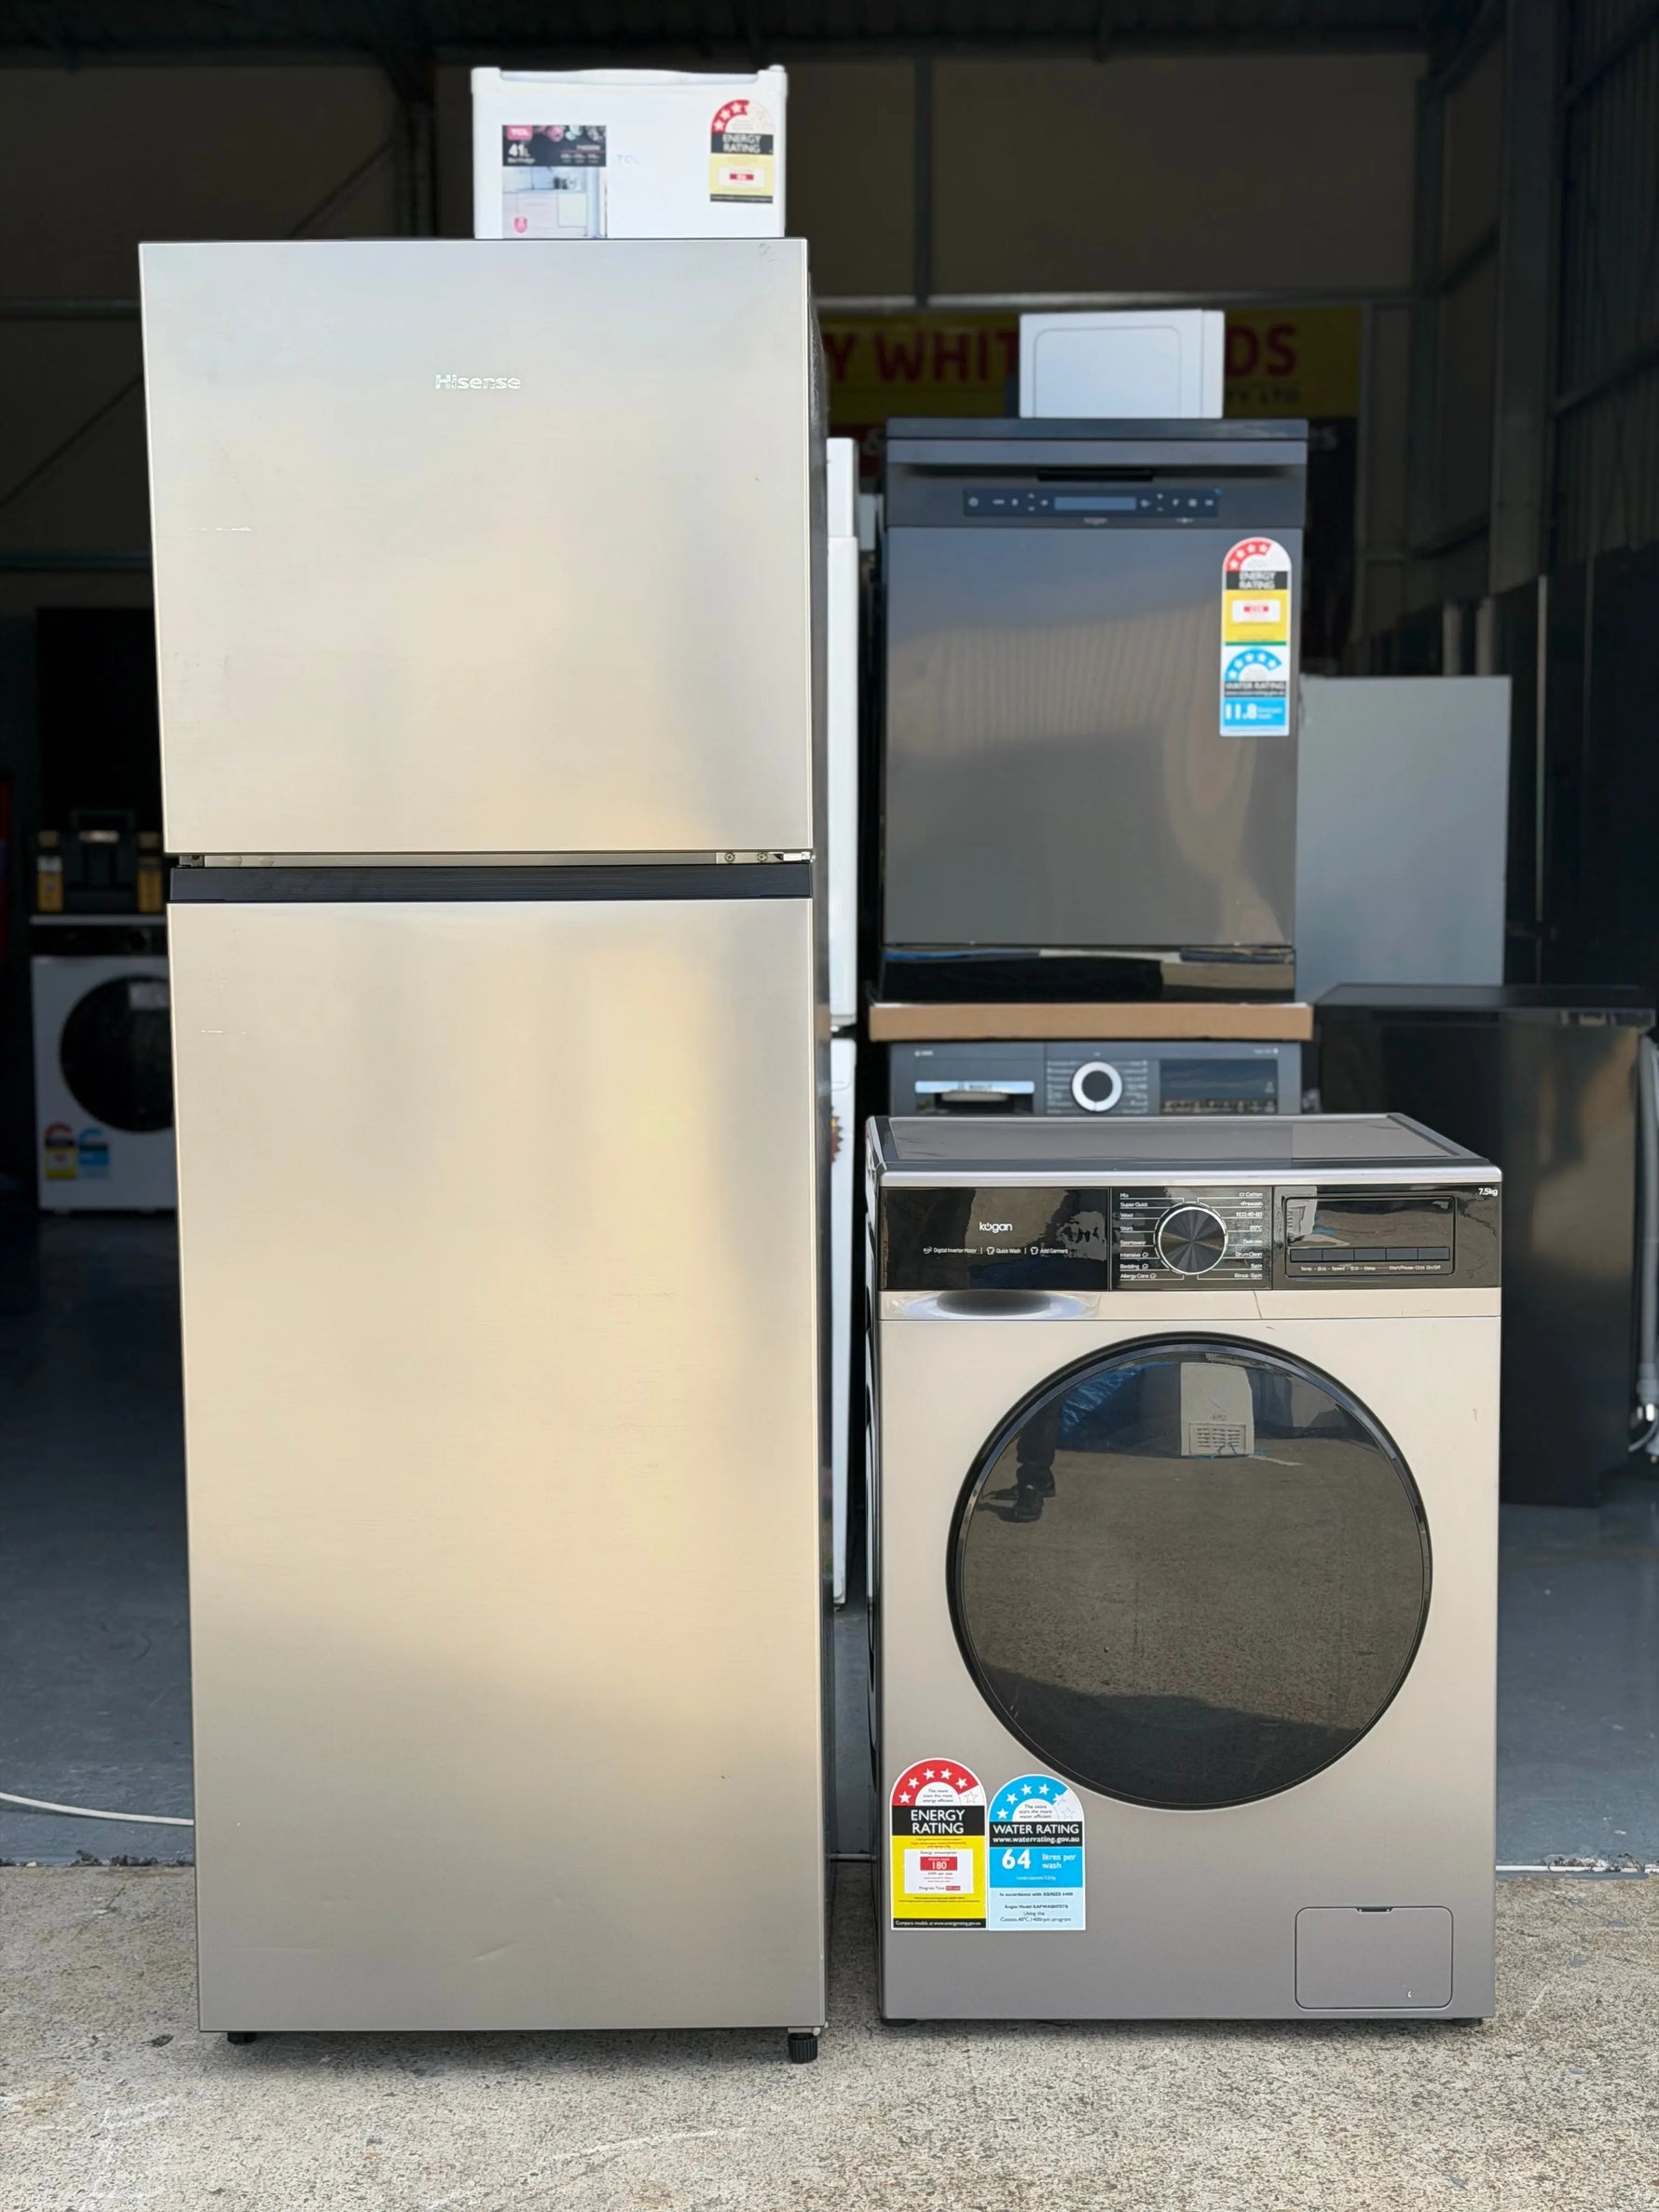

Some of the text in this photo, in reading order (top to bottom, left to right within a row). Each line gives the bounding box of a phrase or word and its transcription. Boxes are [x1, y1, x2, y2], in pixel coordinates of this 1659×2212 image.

[722, 133, 761, 144] ENERGY
[722, 144, 761, 154] RATING
[434, 374, 522, 390] Hisense
[1239, 570, 1276, 581] ENERGY
[1239, 580, 1276, 589] RATING
[1226, 703, 1257, 720] 11.8
[1478, 1188, 1498, 1197] 7.5kg
[979, 1221, 1013, 1233] kogan
[910, 1809, 966, 1821] ENERGY
[912, 1821, 965, 1834] RATING
[992, 1824, 1079, 1834] WATER RATING
[992, 1835, 1080, 1844] www.waterrating.gov.au
[1001, 1848, 1031, 1870] 64
[1063, 1854, 1076, 1862] per
[931, 1861, 948, 1870] 180
